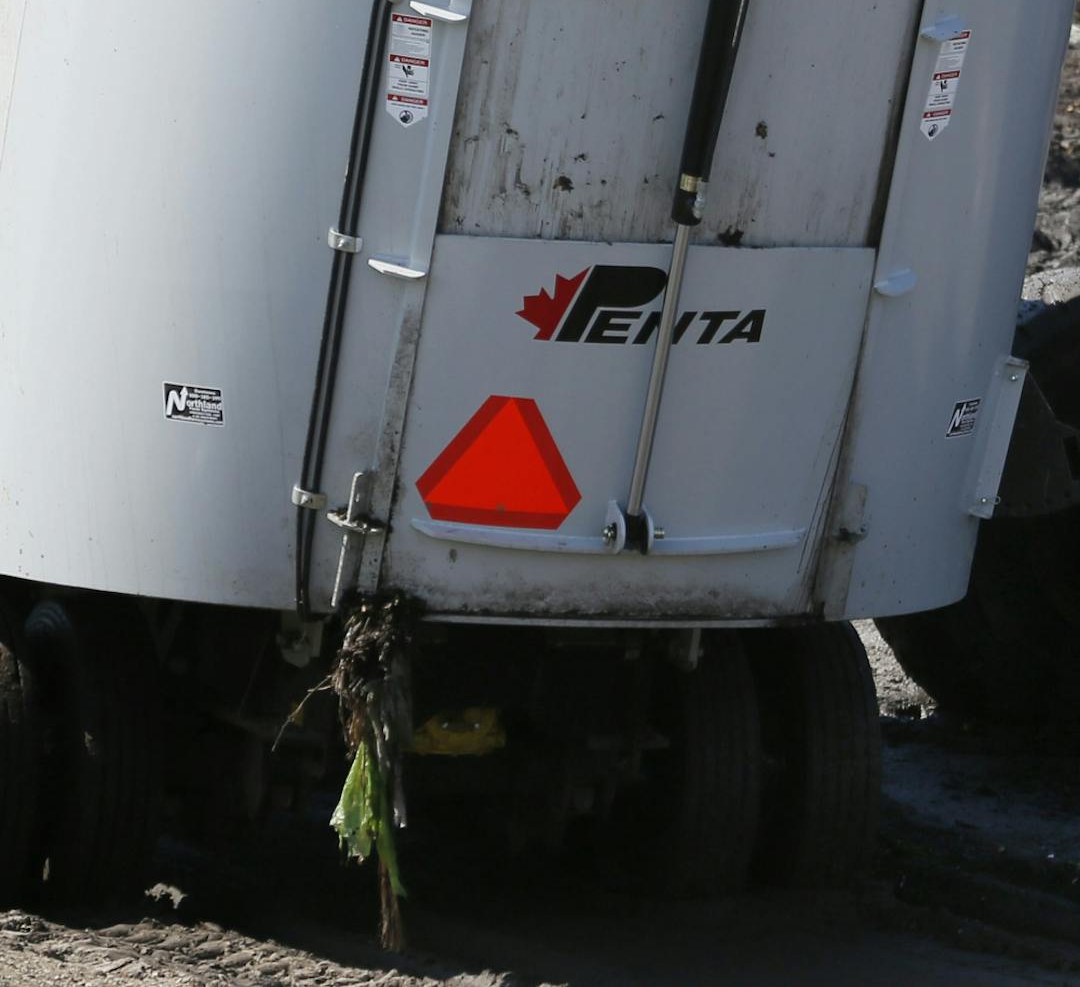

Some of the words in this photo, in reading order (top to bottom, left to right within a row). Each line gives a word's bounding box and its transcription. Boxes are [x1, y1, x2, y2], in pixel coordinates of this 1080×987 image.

[403, 17, 428, 26] DANGER
[401, 57, 426, 66] DANGER
[555, 264, 766, 345] PENTA
